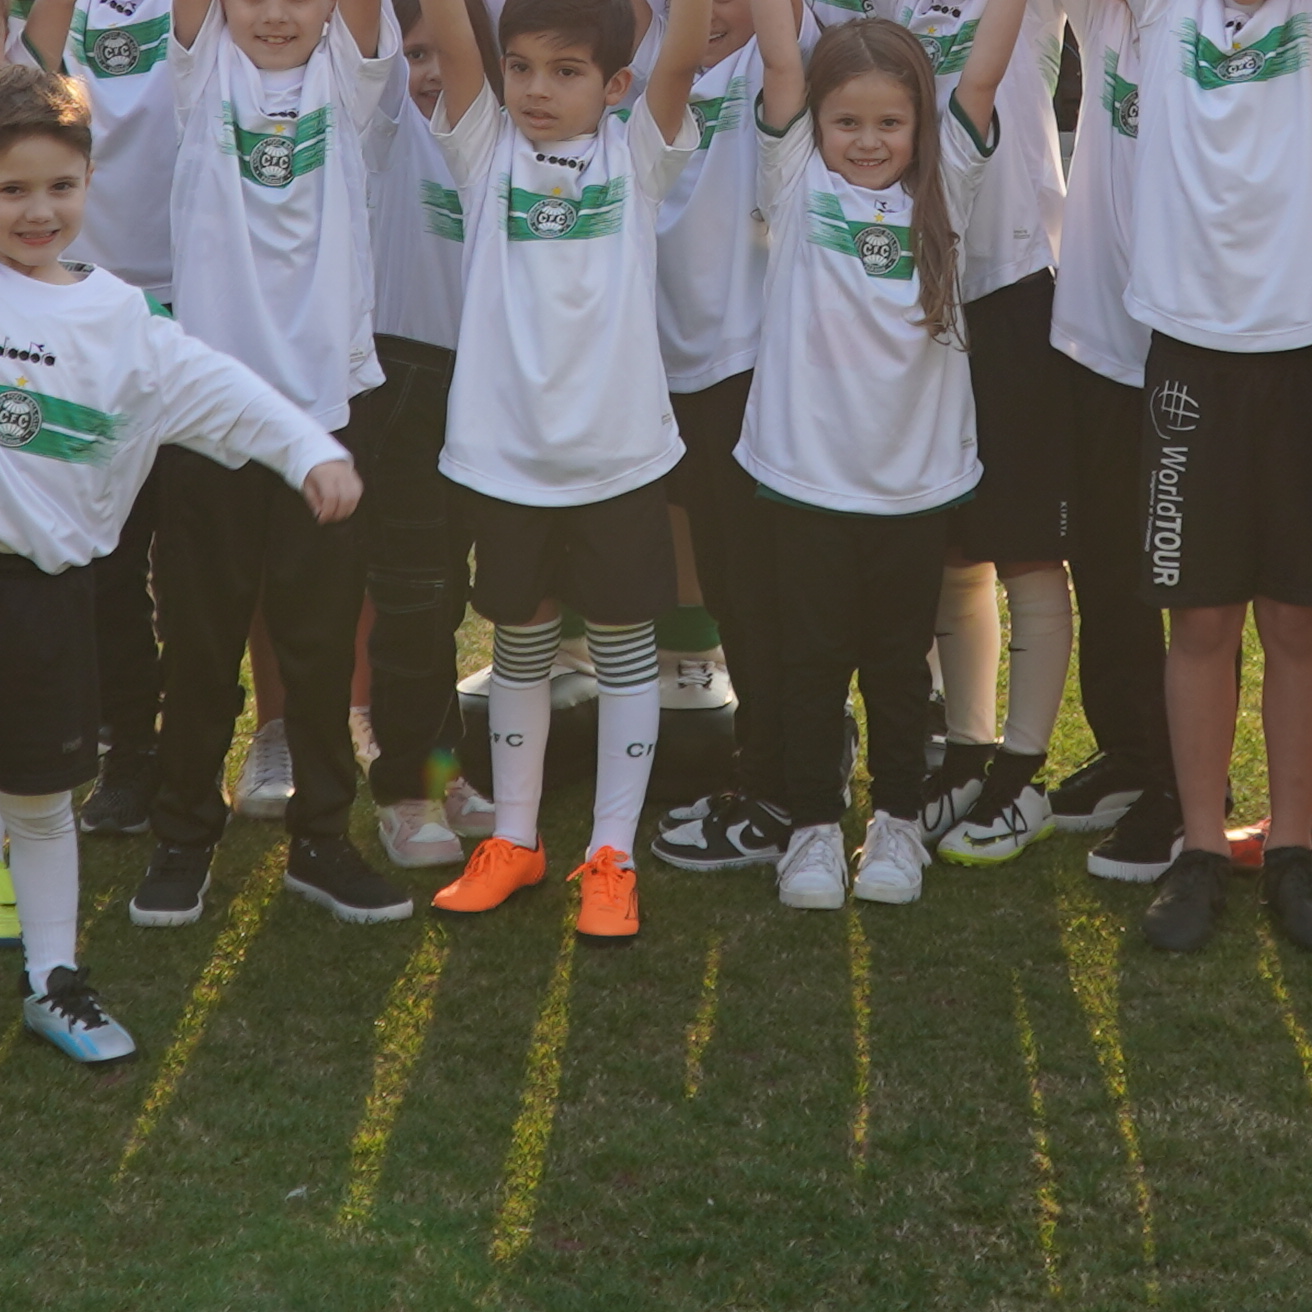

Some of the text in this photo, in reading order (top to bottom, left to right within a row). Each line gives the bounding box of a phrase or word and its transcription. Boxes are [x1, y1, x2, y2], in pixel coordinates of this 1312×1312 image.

[104, 45, 129, 58] CFC
[261, 154, 289, 168] CFC
[538, 213, 566, 225] CFC
[863, 243, 890, 257] CFC
[0, 409, 29, 427] CFC
[1152, 446, 1188, 587] WorldTOUR
